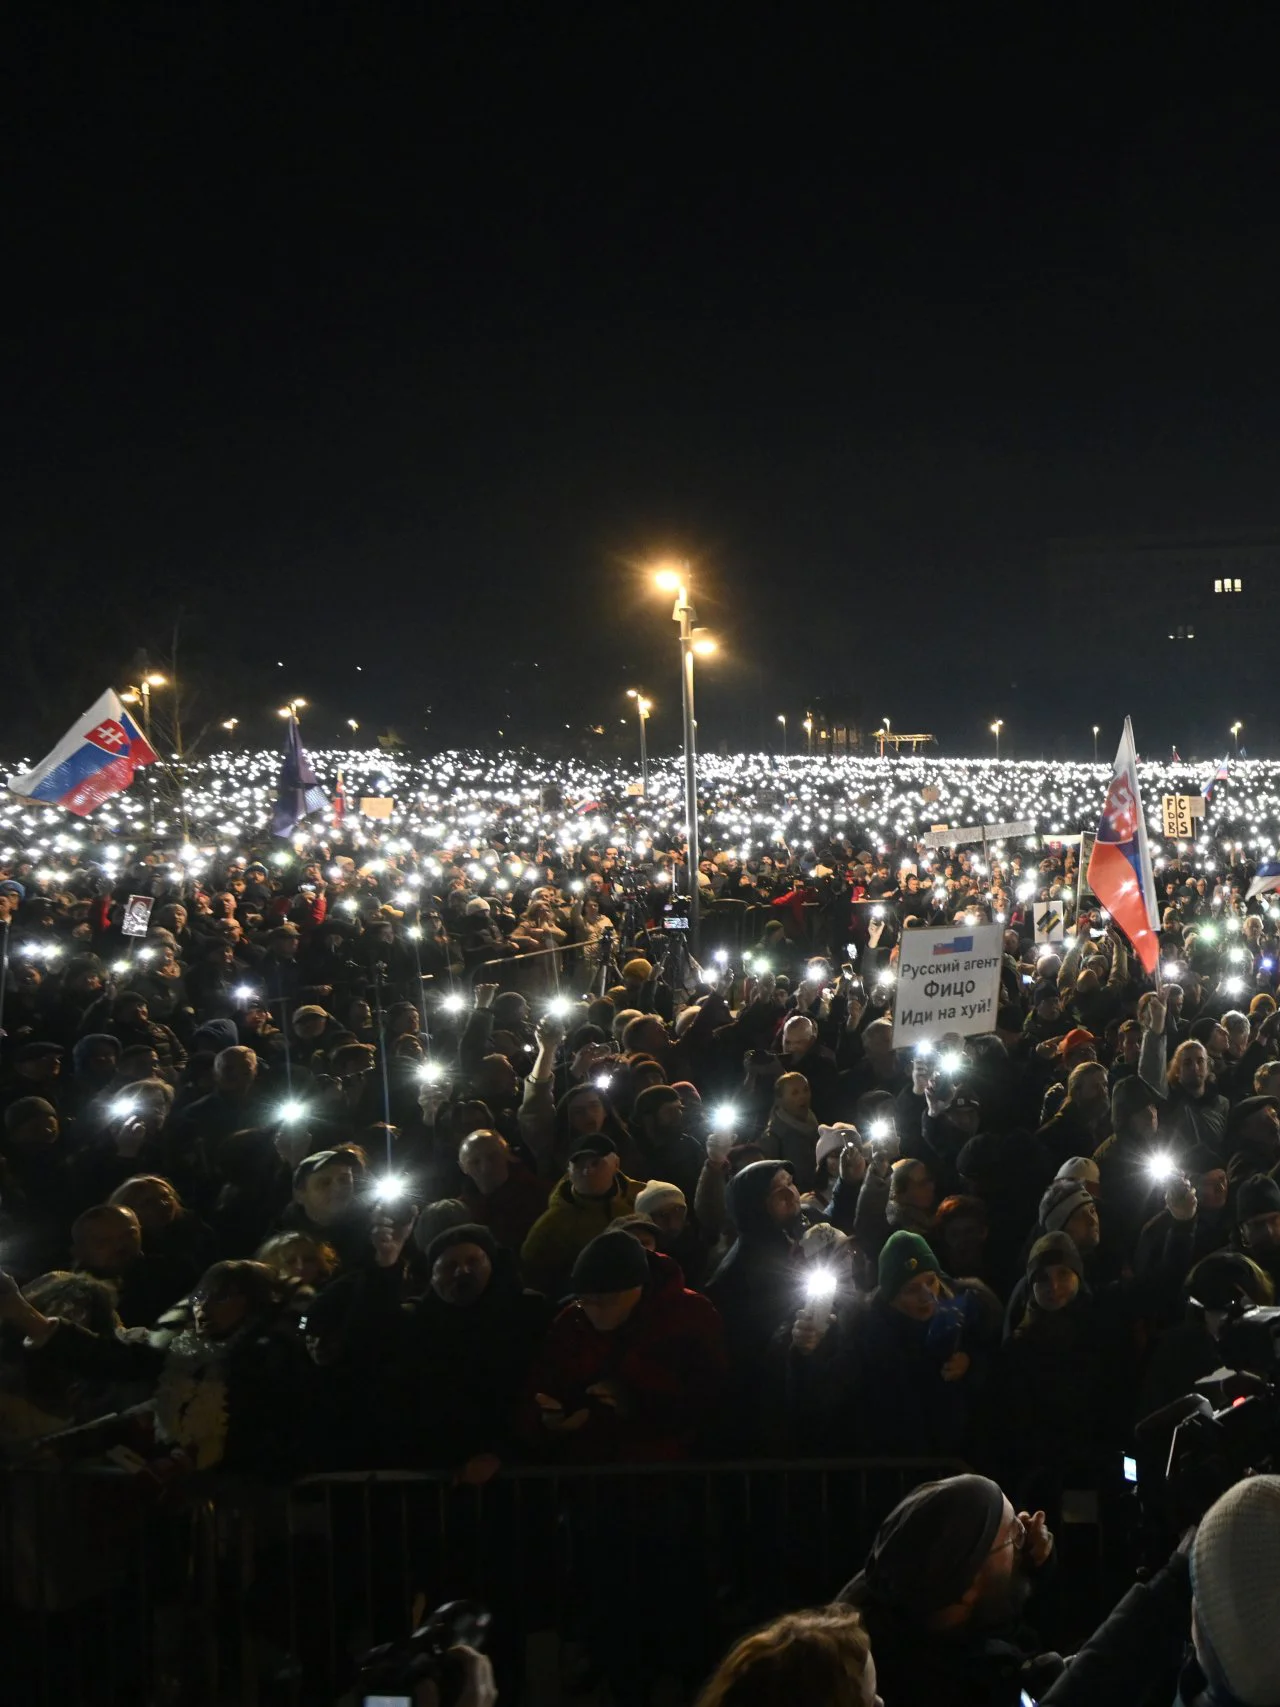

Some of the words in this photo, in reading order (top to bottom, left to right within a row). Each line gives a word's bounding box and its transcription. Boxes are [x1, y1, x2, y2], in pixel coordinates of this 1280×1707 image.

[901, 960, 960, 980] Русский
[964, 957, 1001, 972] агент
[924, 980, 976, 998] Фицо
[901, 1009, 934, 1027] Иди
[938, 1007, 957, 1021] на
[961, 998, 992, 1019] хуй!
